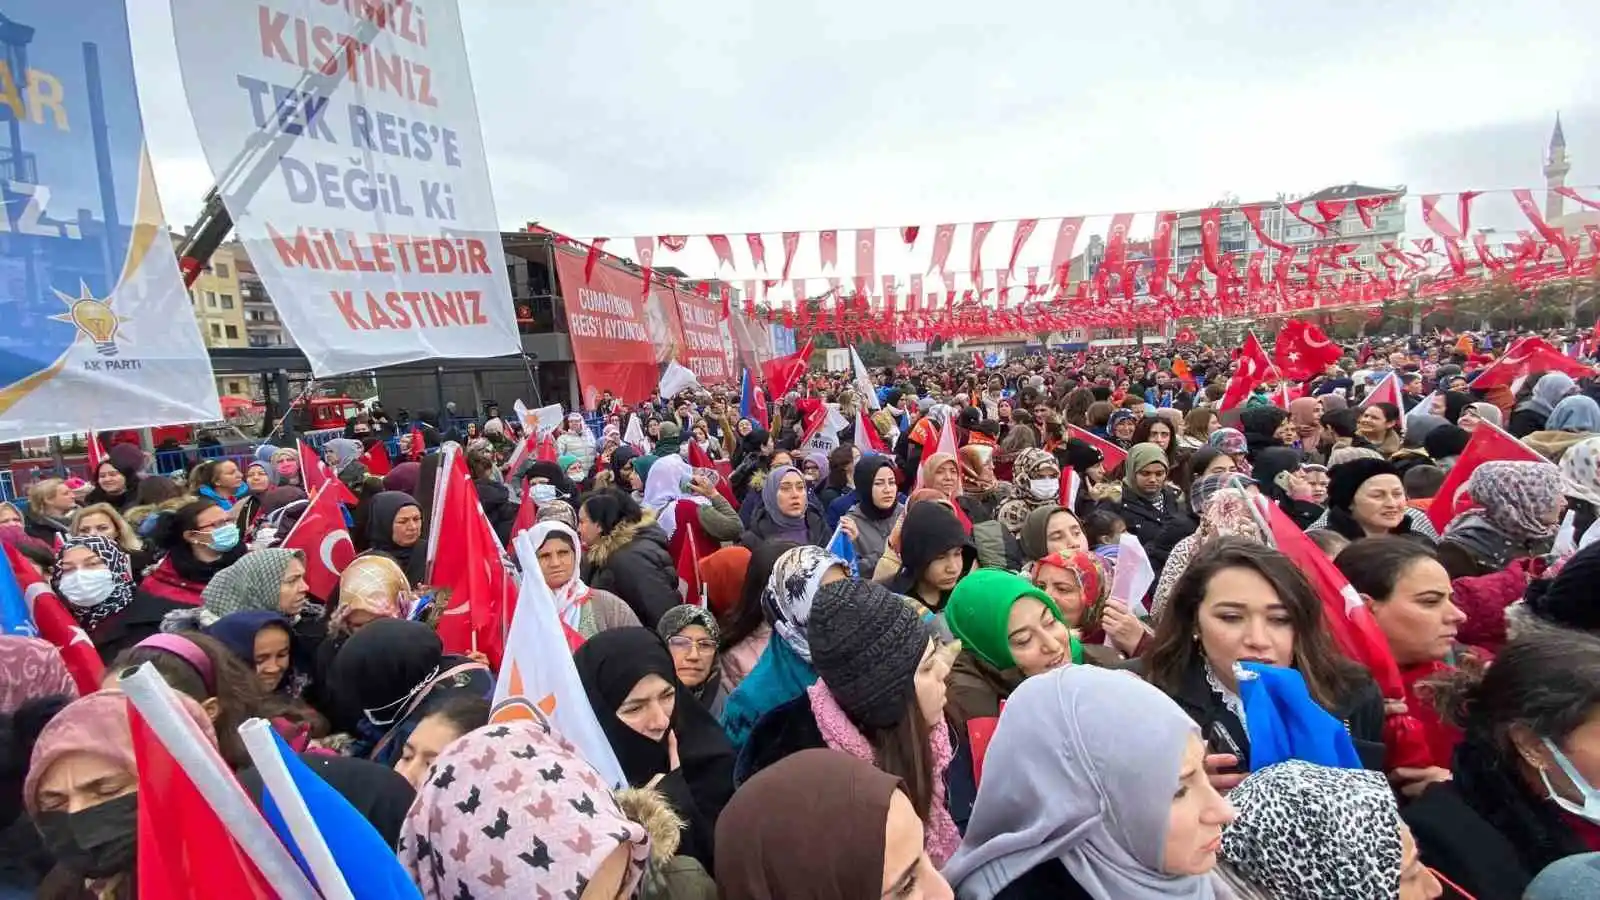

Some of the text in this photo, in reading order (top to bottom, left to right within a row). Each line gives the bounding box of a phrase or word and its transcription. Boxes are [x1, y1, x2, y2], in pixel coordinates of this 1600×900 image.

[258, 5, 438, 107] KISTINIZ
[236, 74, 338, 144] TEK
[330, 290, 488, 331] KASTINIZ
[84, 360, 101, 371] AK
